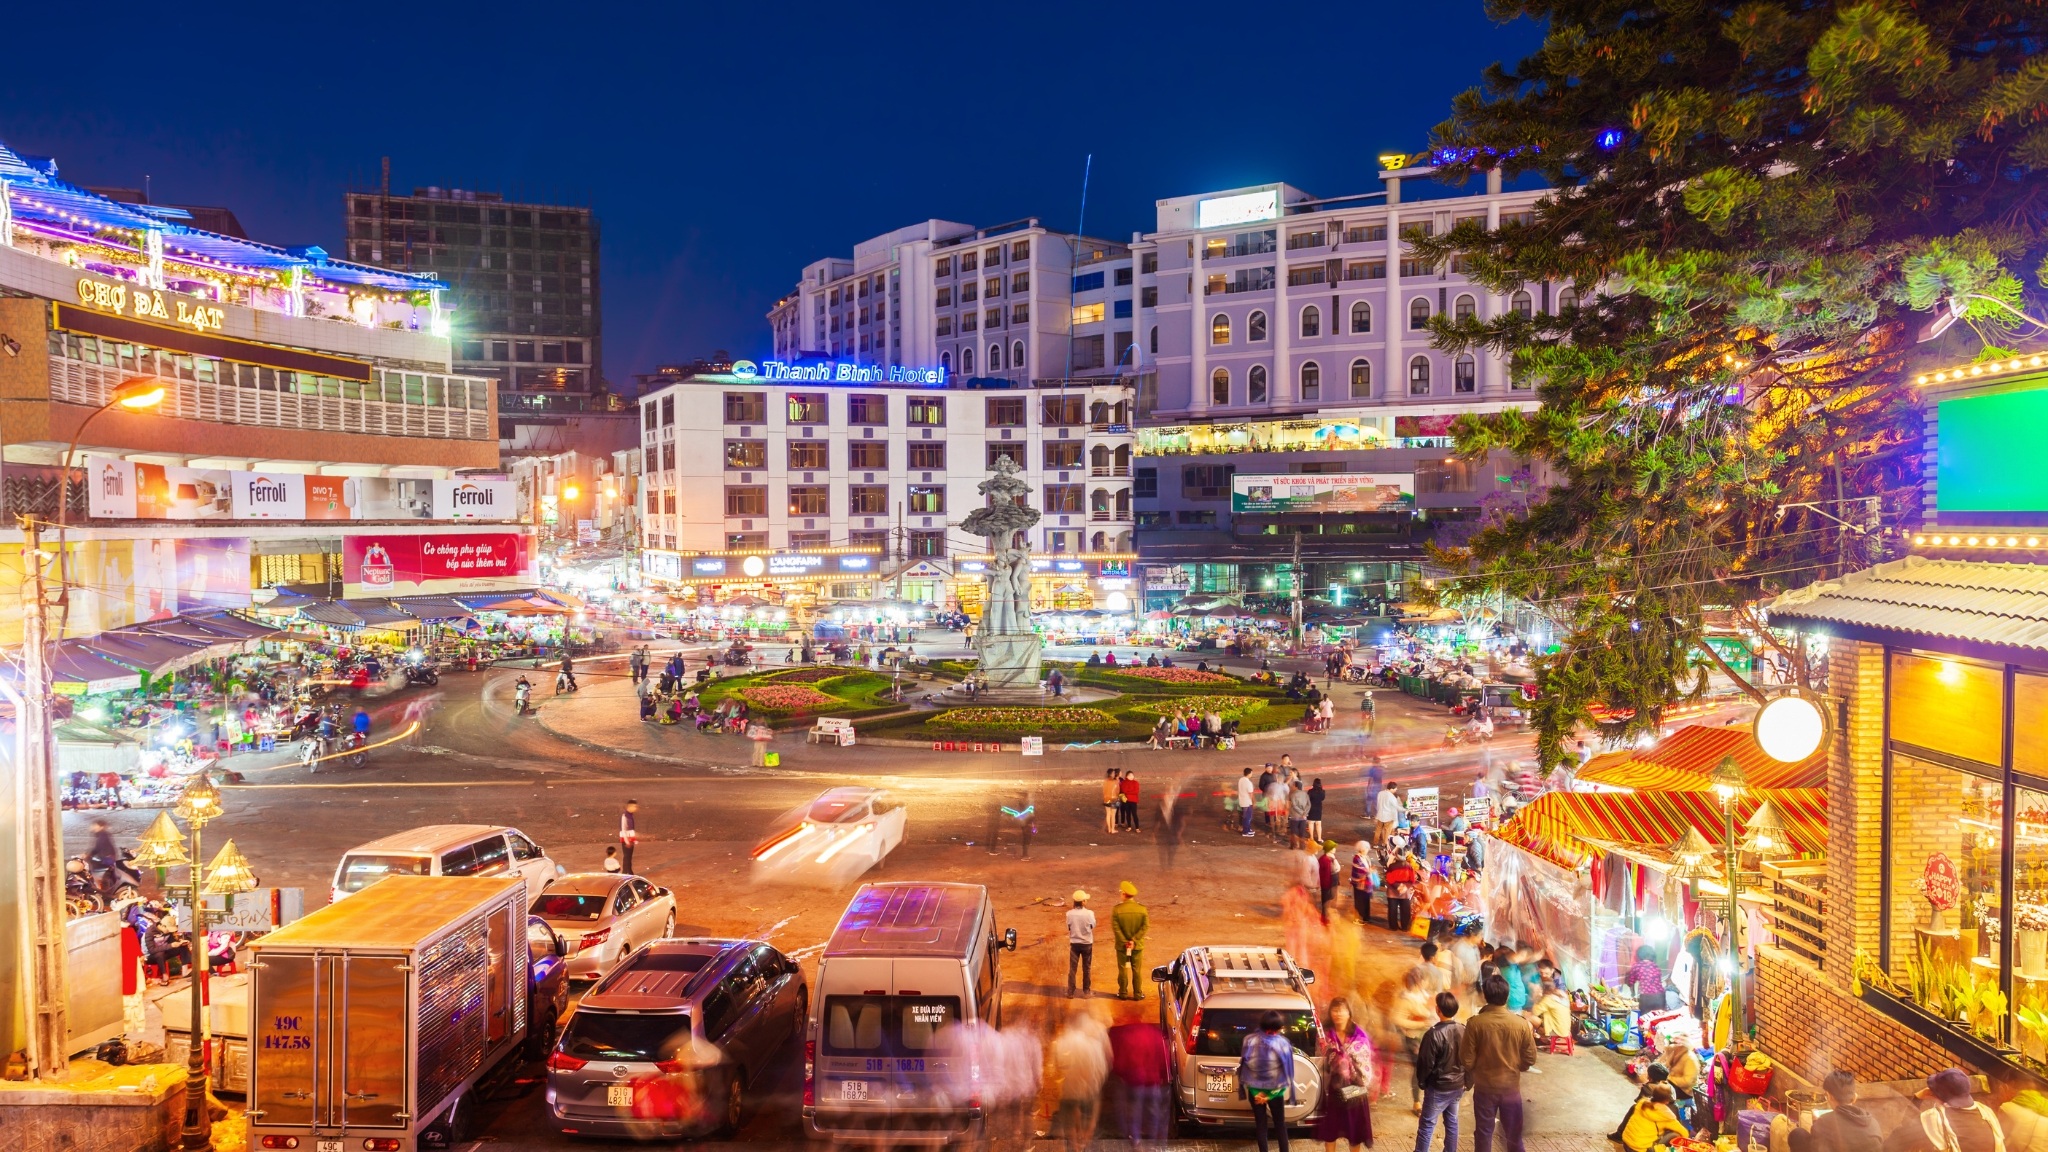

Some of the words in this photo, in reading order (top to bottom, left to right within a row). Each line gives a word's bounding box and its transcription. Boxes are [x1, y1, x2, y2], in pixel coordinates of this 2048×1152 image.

[78, 278, 126, 315] CHỢ
[133, 290, 169, 319] ĐÀ
[176, 300, 225, 332] LẠT
[763, 361, 829, 380] Thanh
[889, 366, 945, 384] Hotel
[249, 481, 287, 506] Ferroli
[312, 486, 327, 495] DIVO
[453, 487, 493, 508] Ferroli
[460, 544, 475, 556] phụ
[475, 543, 493, 557] giúp
[446, 557, 460, 571] bếp
[476, 557, 494, 568] thêm
[495, 557, 507, 567] vui
[222, 567, 240, 585] PNJ
[363, 567, 391, 576] Neptune
[373, 575, 390, 583] Gold
[1930, 871, 1952, 885] HAPPY
[1931, 885, 1952, 903] 2018
[911, 1006, 919, 1014] XE
[274, 1016, 302, 1030] 49C
[914, 1015, 929, 1023] NHÂN
[264, 1034, 311, 1050] 147.58
[866, 1058, 883, 1071] 51B
[896, 1059, 925, 1071] 168.79
[613, 1087, 628, 1096] 51G
[847, 1082, 862, 1090] 51B
[842, 1090, 867, 1100] 168.79
[322, 1141, 338, 1150] 49C
